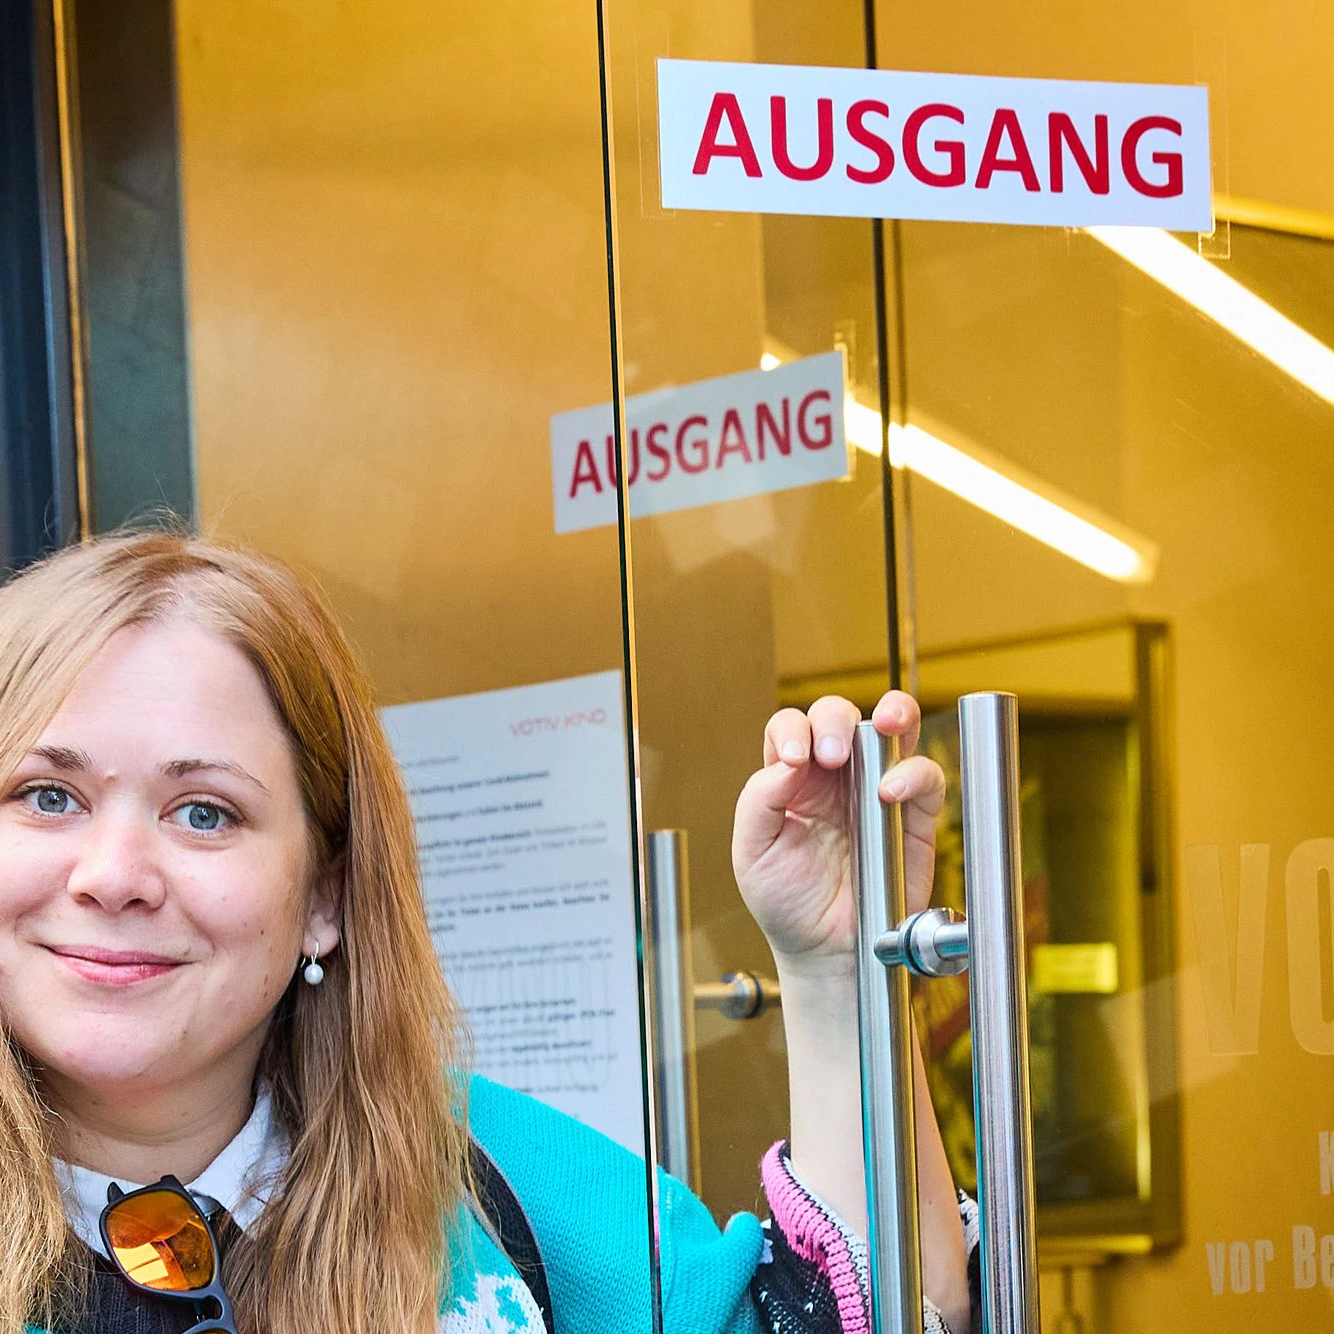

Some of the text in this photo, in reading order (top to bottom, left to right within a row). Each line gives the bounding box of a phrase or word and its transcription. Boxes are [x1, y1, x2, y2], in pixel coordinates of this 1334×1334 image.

[692, 93, 1183, 199] AUSGANG
[569, 390, 833, 499] AUSGANG
[1205, 1238, 1274, 1296] vor
